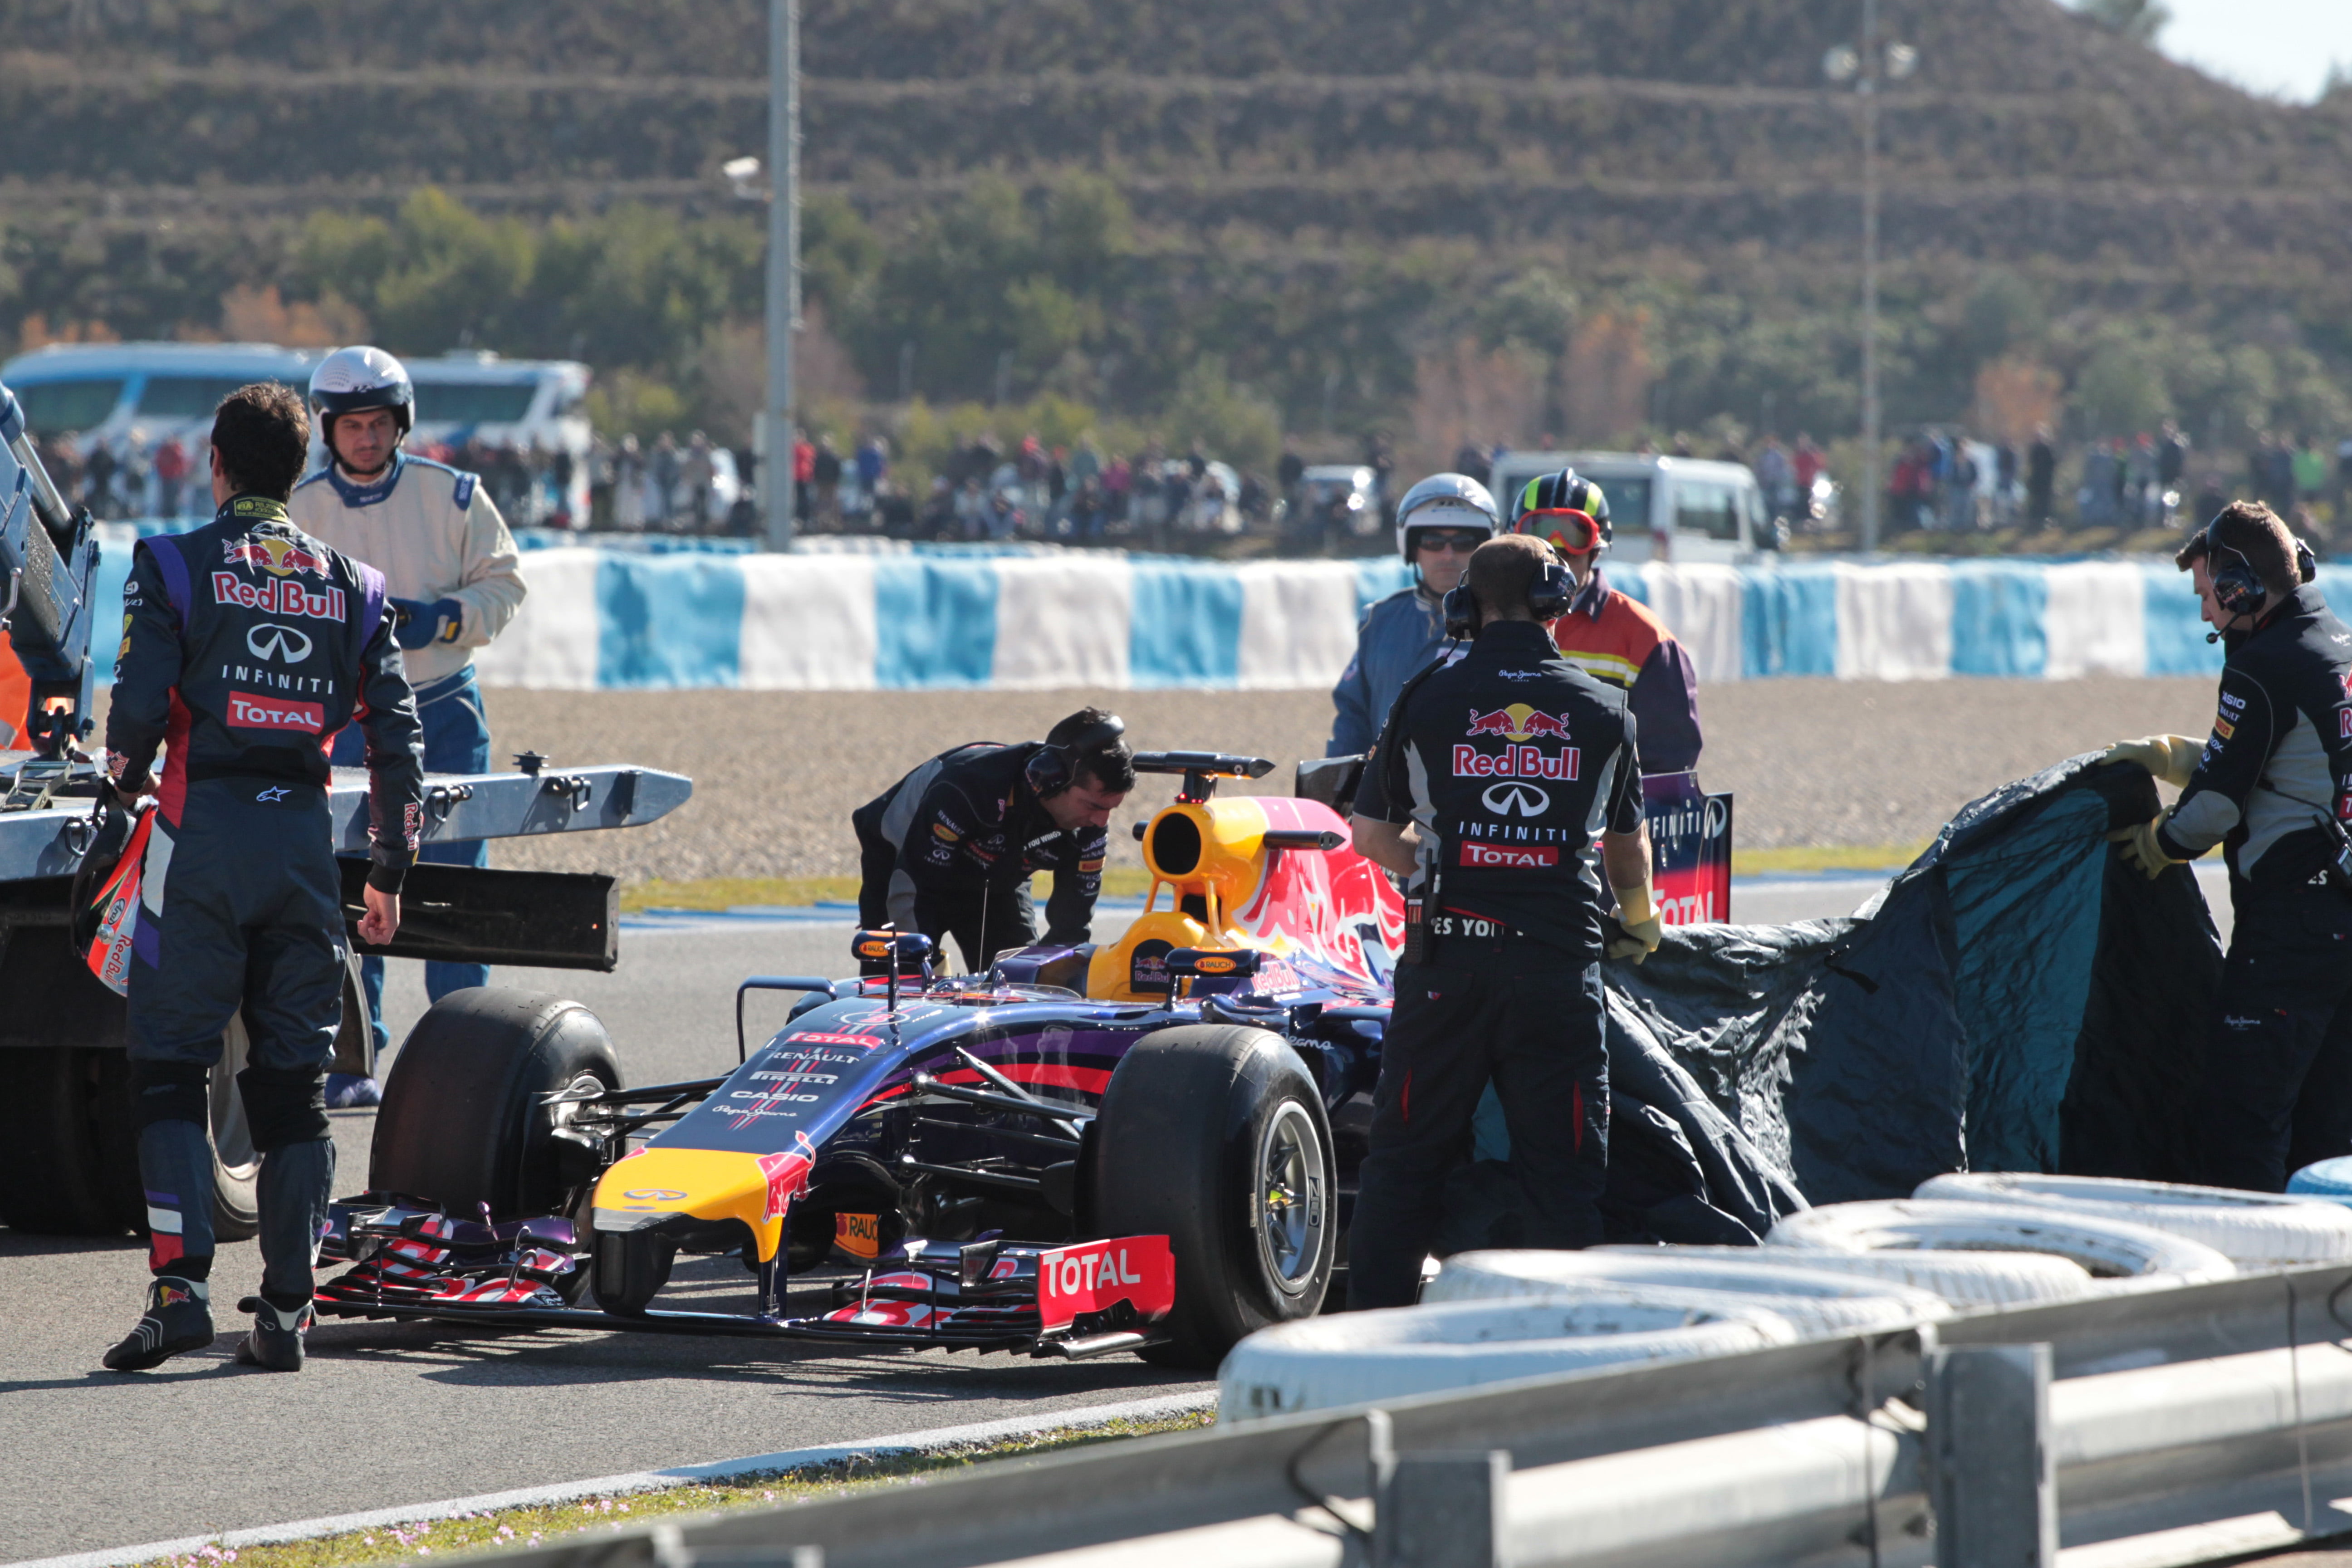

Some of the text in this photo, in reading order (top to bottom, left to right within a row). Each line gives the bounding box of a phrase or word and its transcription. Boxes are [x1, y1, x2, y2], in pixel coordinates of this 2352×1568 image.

[211, 571, 345, 623] Red Bull
[222, 665, 333, 694] INFINITI
[2222, 690, 2246, 710] ASIO
[232, 700, 321, 727] TOTAL
[1453, 745, 1580, 781] Red Bull
[1459, 821, 1566, 841] INFINITI
[1647, 811, 1700, 838] FINITI
[1040, 831, 1061, 843] WINGS
[1467, 845, 1552, 866] TOTAL
[105, 934, 132, 985] Red Bull
[1155, 971, 1171, 983] Bul
[790, 1032, 873, 1048] TOTAL
[773, 1052, 860, 1063] RENAULT
[749, 1071, 838, 1084] PIRELLI
[730, 1091, 819, 1102] CASIO
[712, 1105, 798, 1117] Pepe Jeans
[849, 1216, 878, 1241] RAUC
[1044, 1249, 1141, 1298] TOTAL
